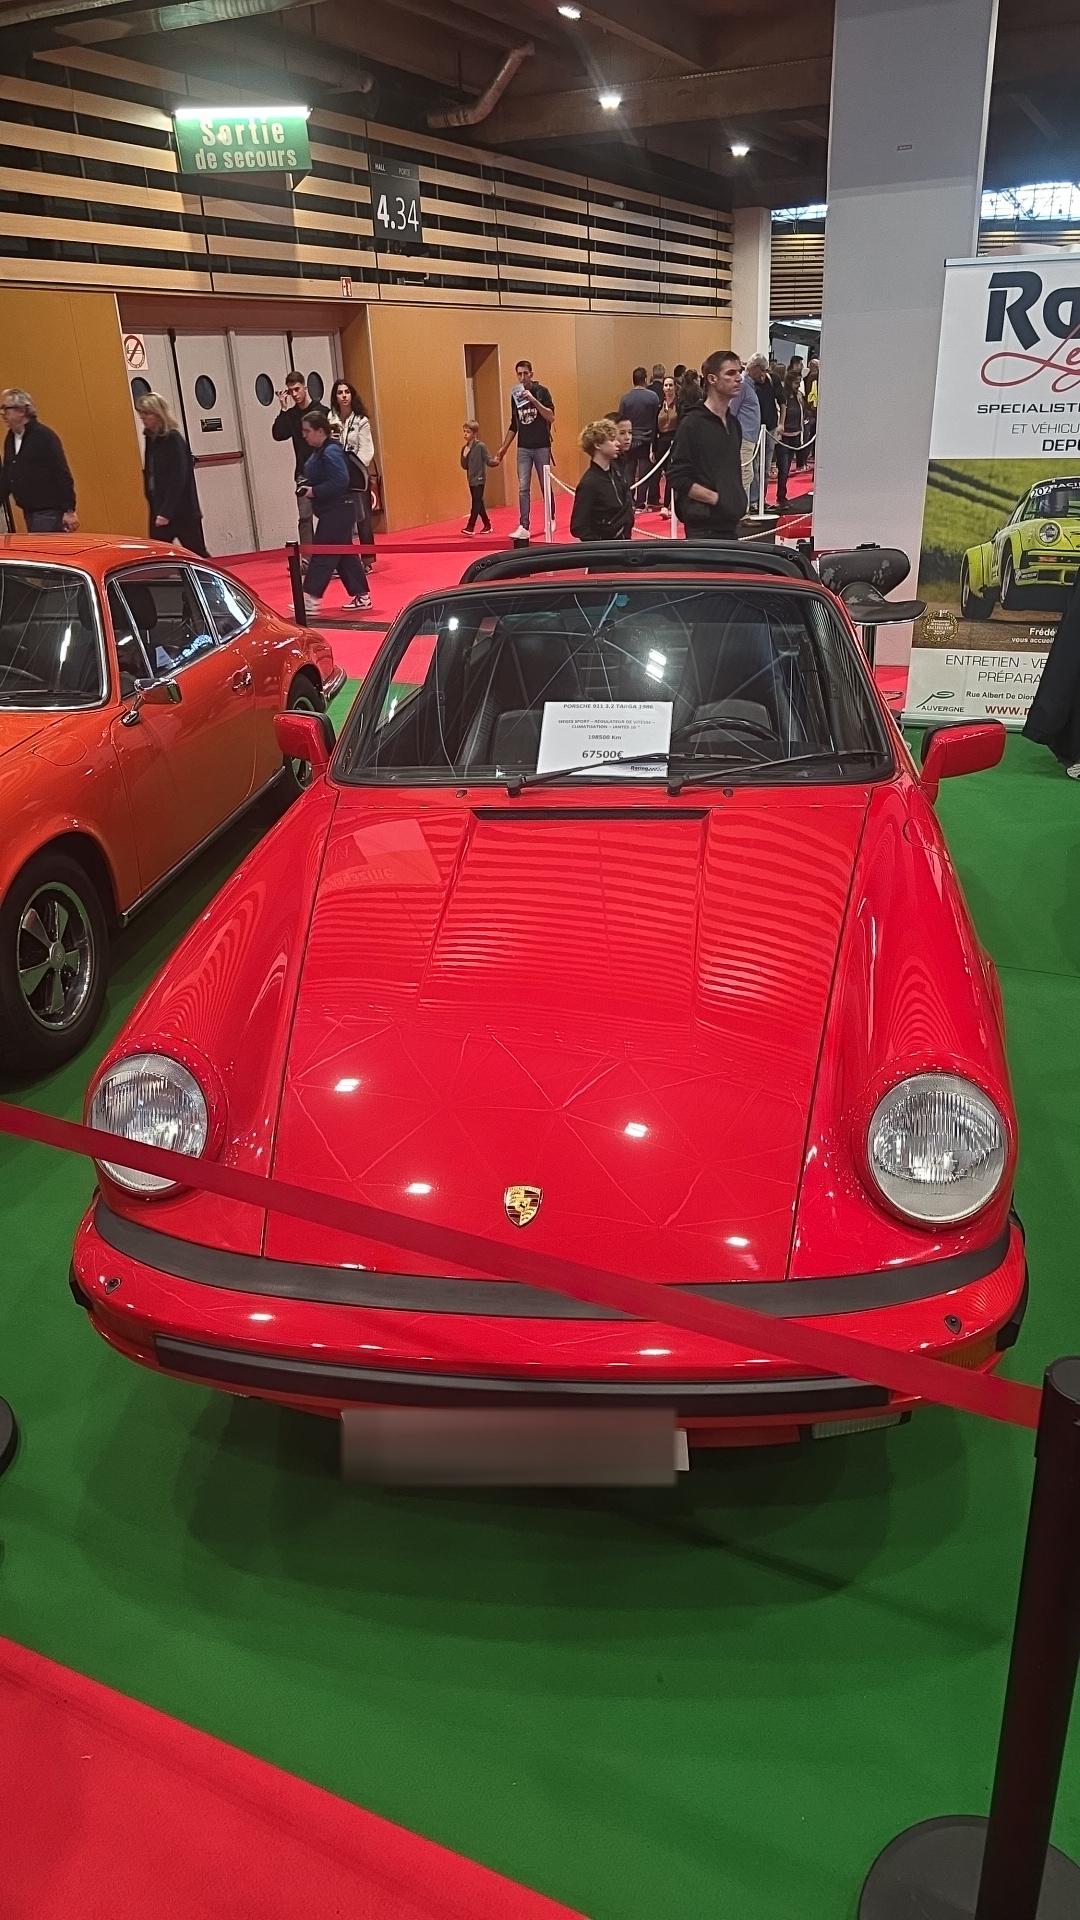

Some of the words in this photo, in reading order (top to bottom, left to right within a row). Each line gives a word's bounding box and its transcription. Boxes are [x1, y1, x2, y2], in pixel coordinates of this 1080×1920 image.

[201, 117, 285, 146] Sortie
[195, 149, 217, 170] de
[223, 150, 297, 169] secours
[375, 163, 386, 172] HALL
[377, 194, 419, 232] 4.34
[977, 403, 1080, 414] SPECIALIST
[1011, 424, 1028, 434] ET
[1029, 627, 1057, 637] Frédé
[945, 655, 1020, 668] ENTRETIEN
[978, 670, 1041, 684] PRÉPARA
[966, 691, 981, 699] Rue
[982, 691, 1004, 699] Albert
[921, 705, 965, 713] AUVERGNE
[582, 750, 624, 759] 67500€
